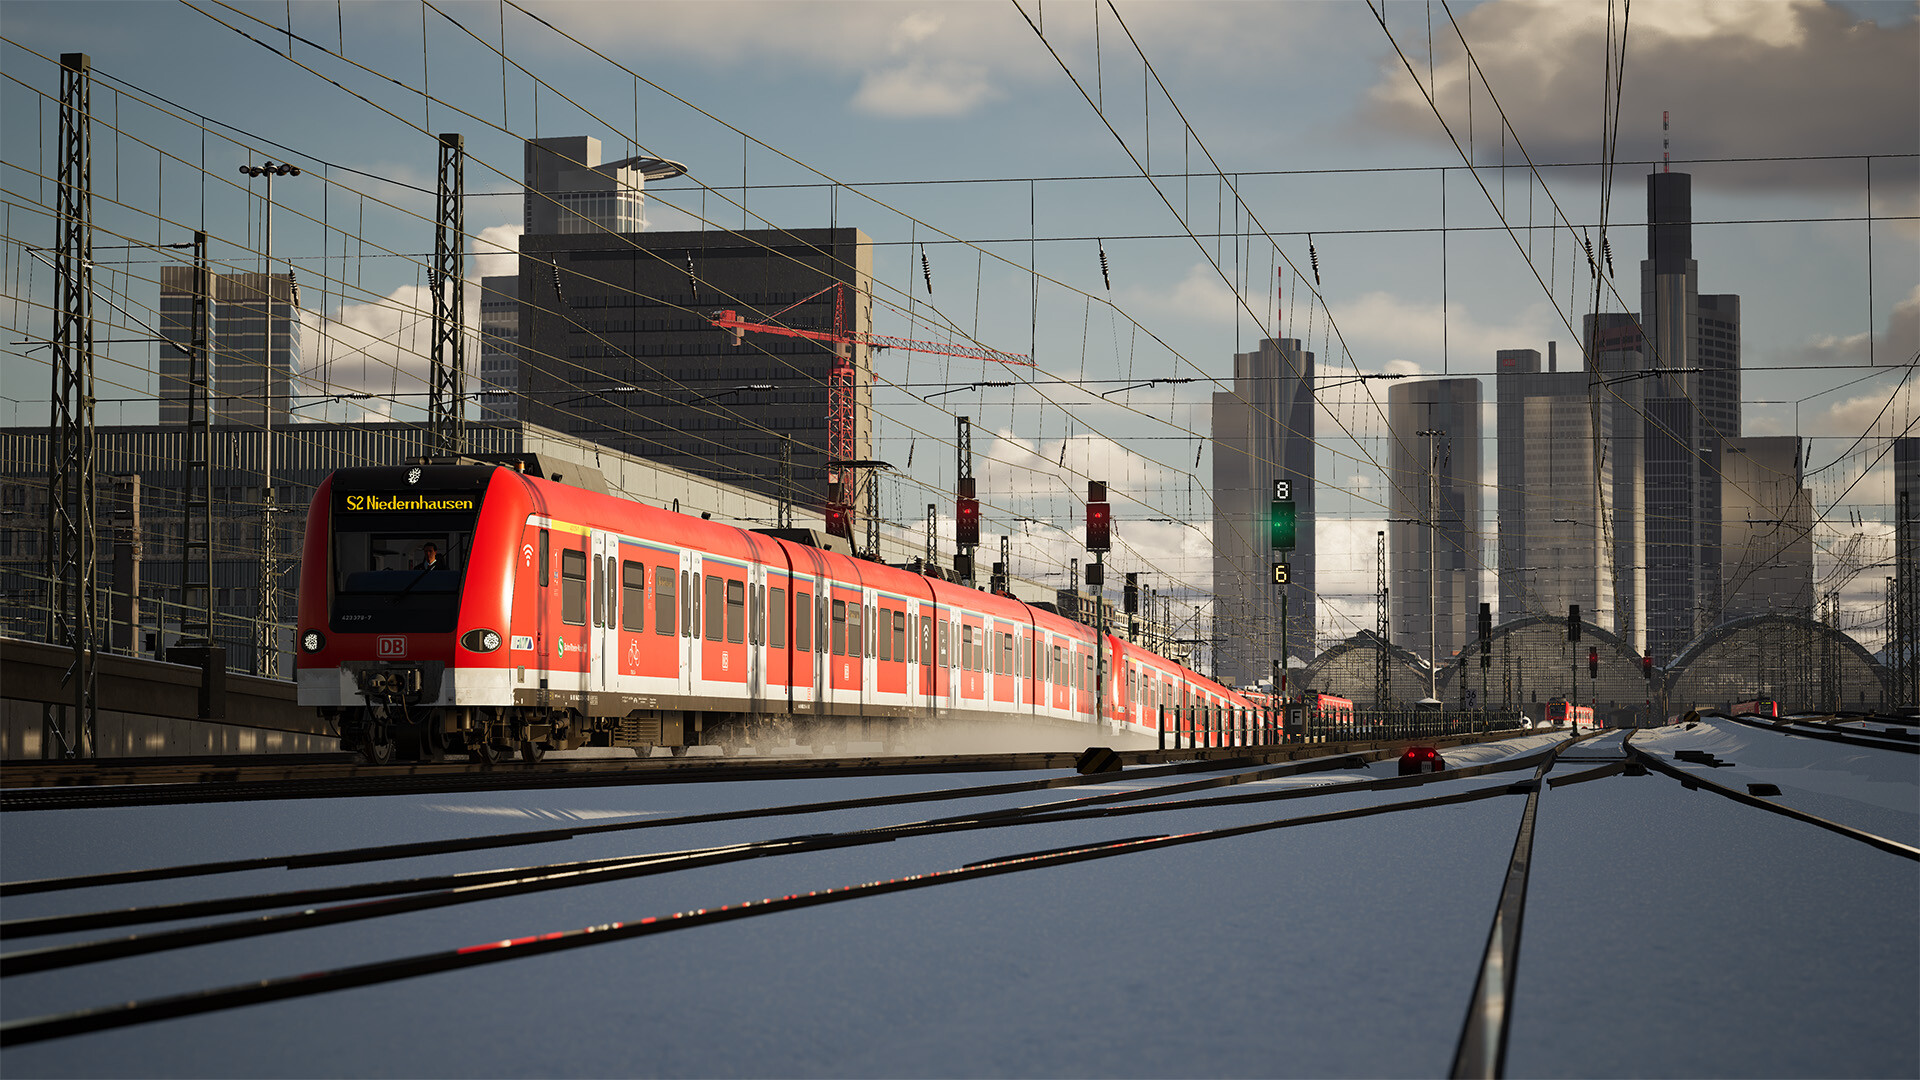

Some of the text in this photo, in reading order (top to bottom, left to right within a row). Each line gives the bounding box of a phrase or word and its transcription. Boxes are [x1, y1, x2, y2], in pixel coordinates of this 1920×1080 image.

[1276, 481, 1289, 500] 8
[346, 494, 473, 511] S2 Niedernhausen
[1275, 565, 1287, 583] 6
[381, 639, 404, 653] DB
[1465, 690, 1477, 699] 36
[1468, 698, 1474, 707] 6
[1292, 710, 1301, 723] F
